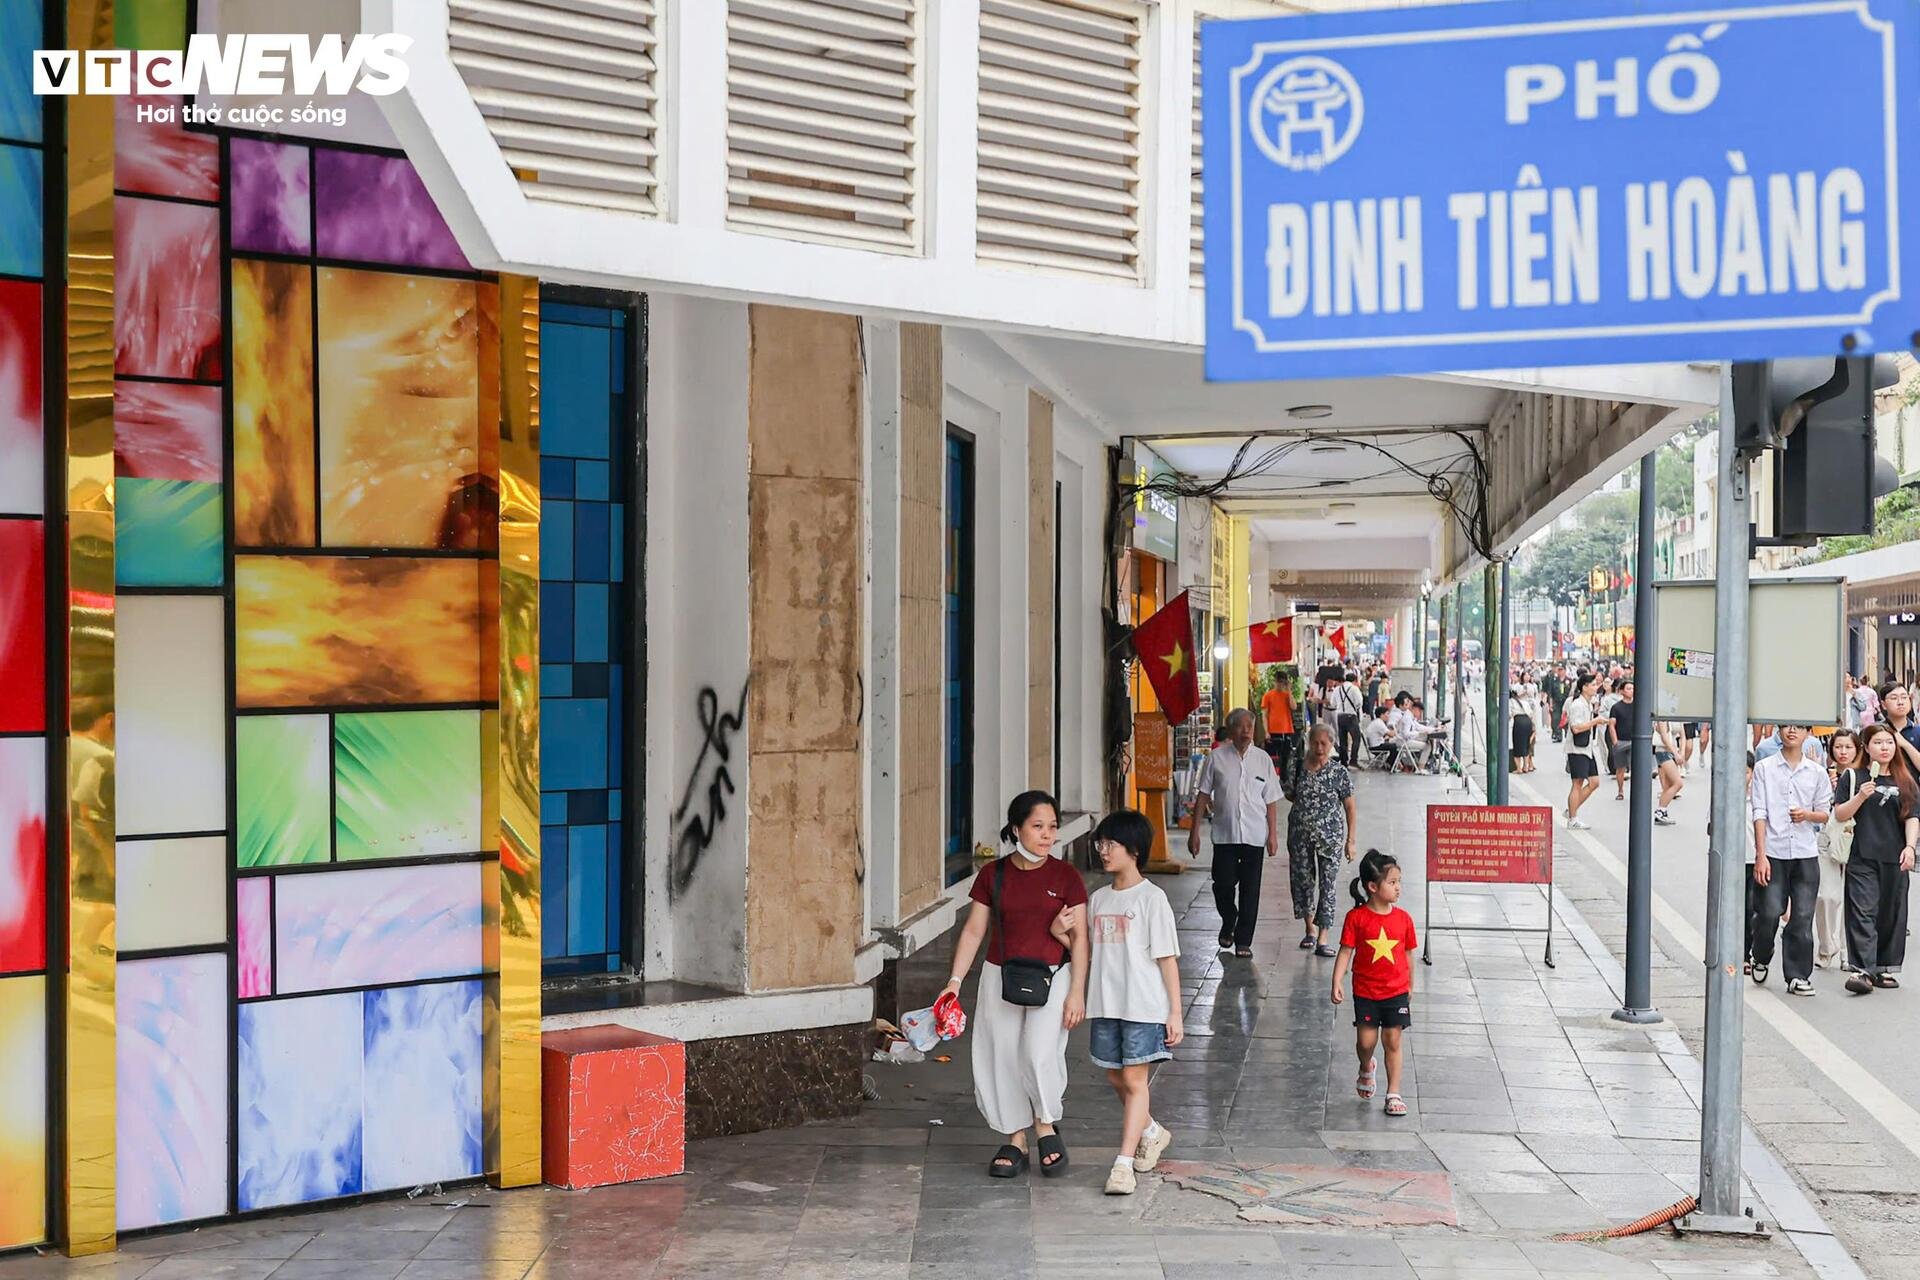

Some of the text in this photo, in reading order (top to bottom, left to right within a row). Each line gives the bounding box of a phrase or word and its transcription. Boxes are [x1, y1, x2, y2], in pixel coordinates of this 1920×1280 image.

[1505, 23, 1729, 124] PHỐ
[1265, 151, 1867, 318] ĐINH TIÊN HOÀNG
[1497, 813, 1518, 824] MINH
